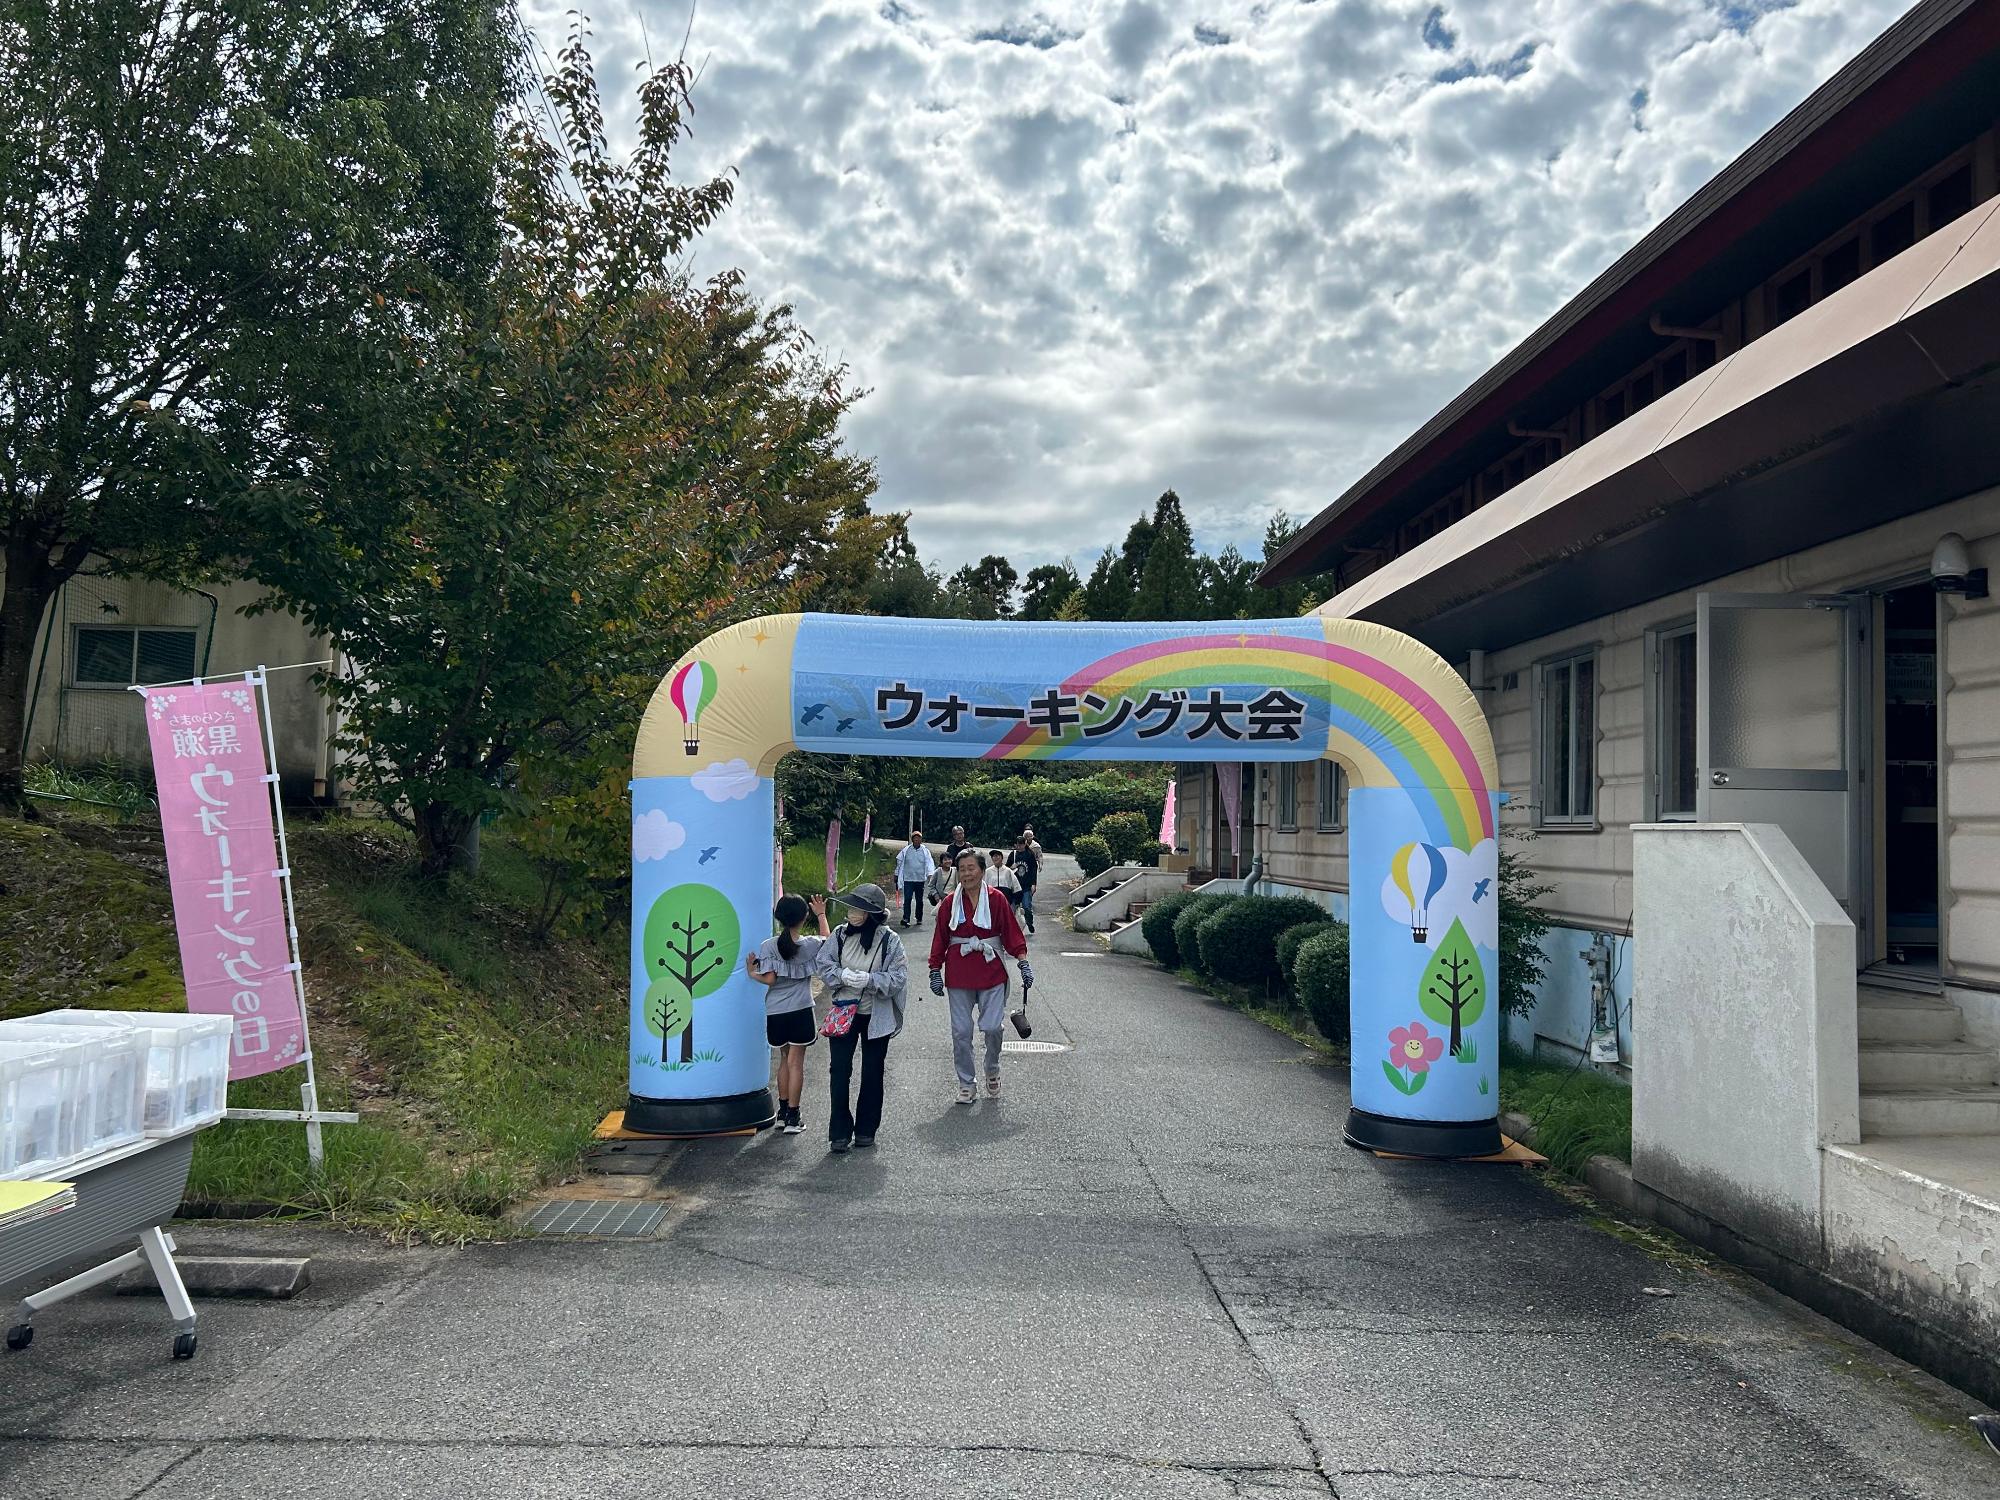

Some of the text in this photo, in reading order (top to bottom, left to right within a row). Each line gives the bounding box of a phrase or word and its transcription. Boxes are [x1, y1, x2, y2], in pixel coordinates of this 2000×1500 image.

[876, 682, 1306, 741] ウォーキング大会
